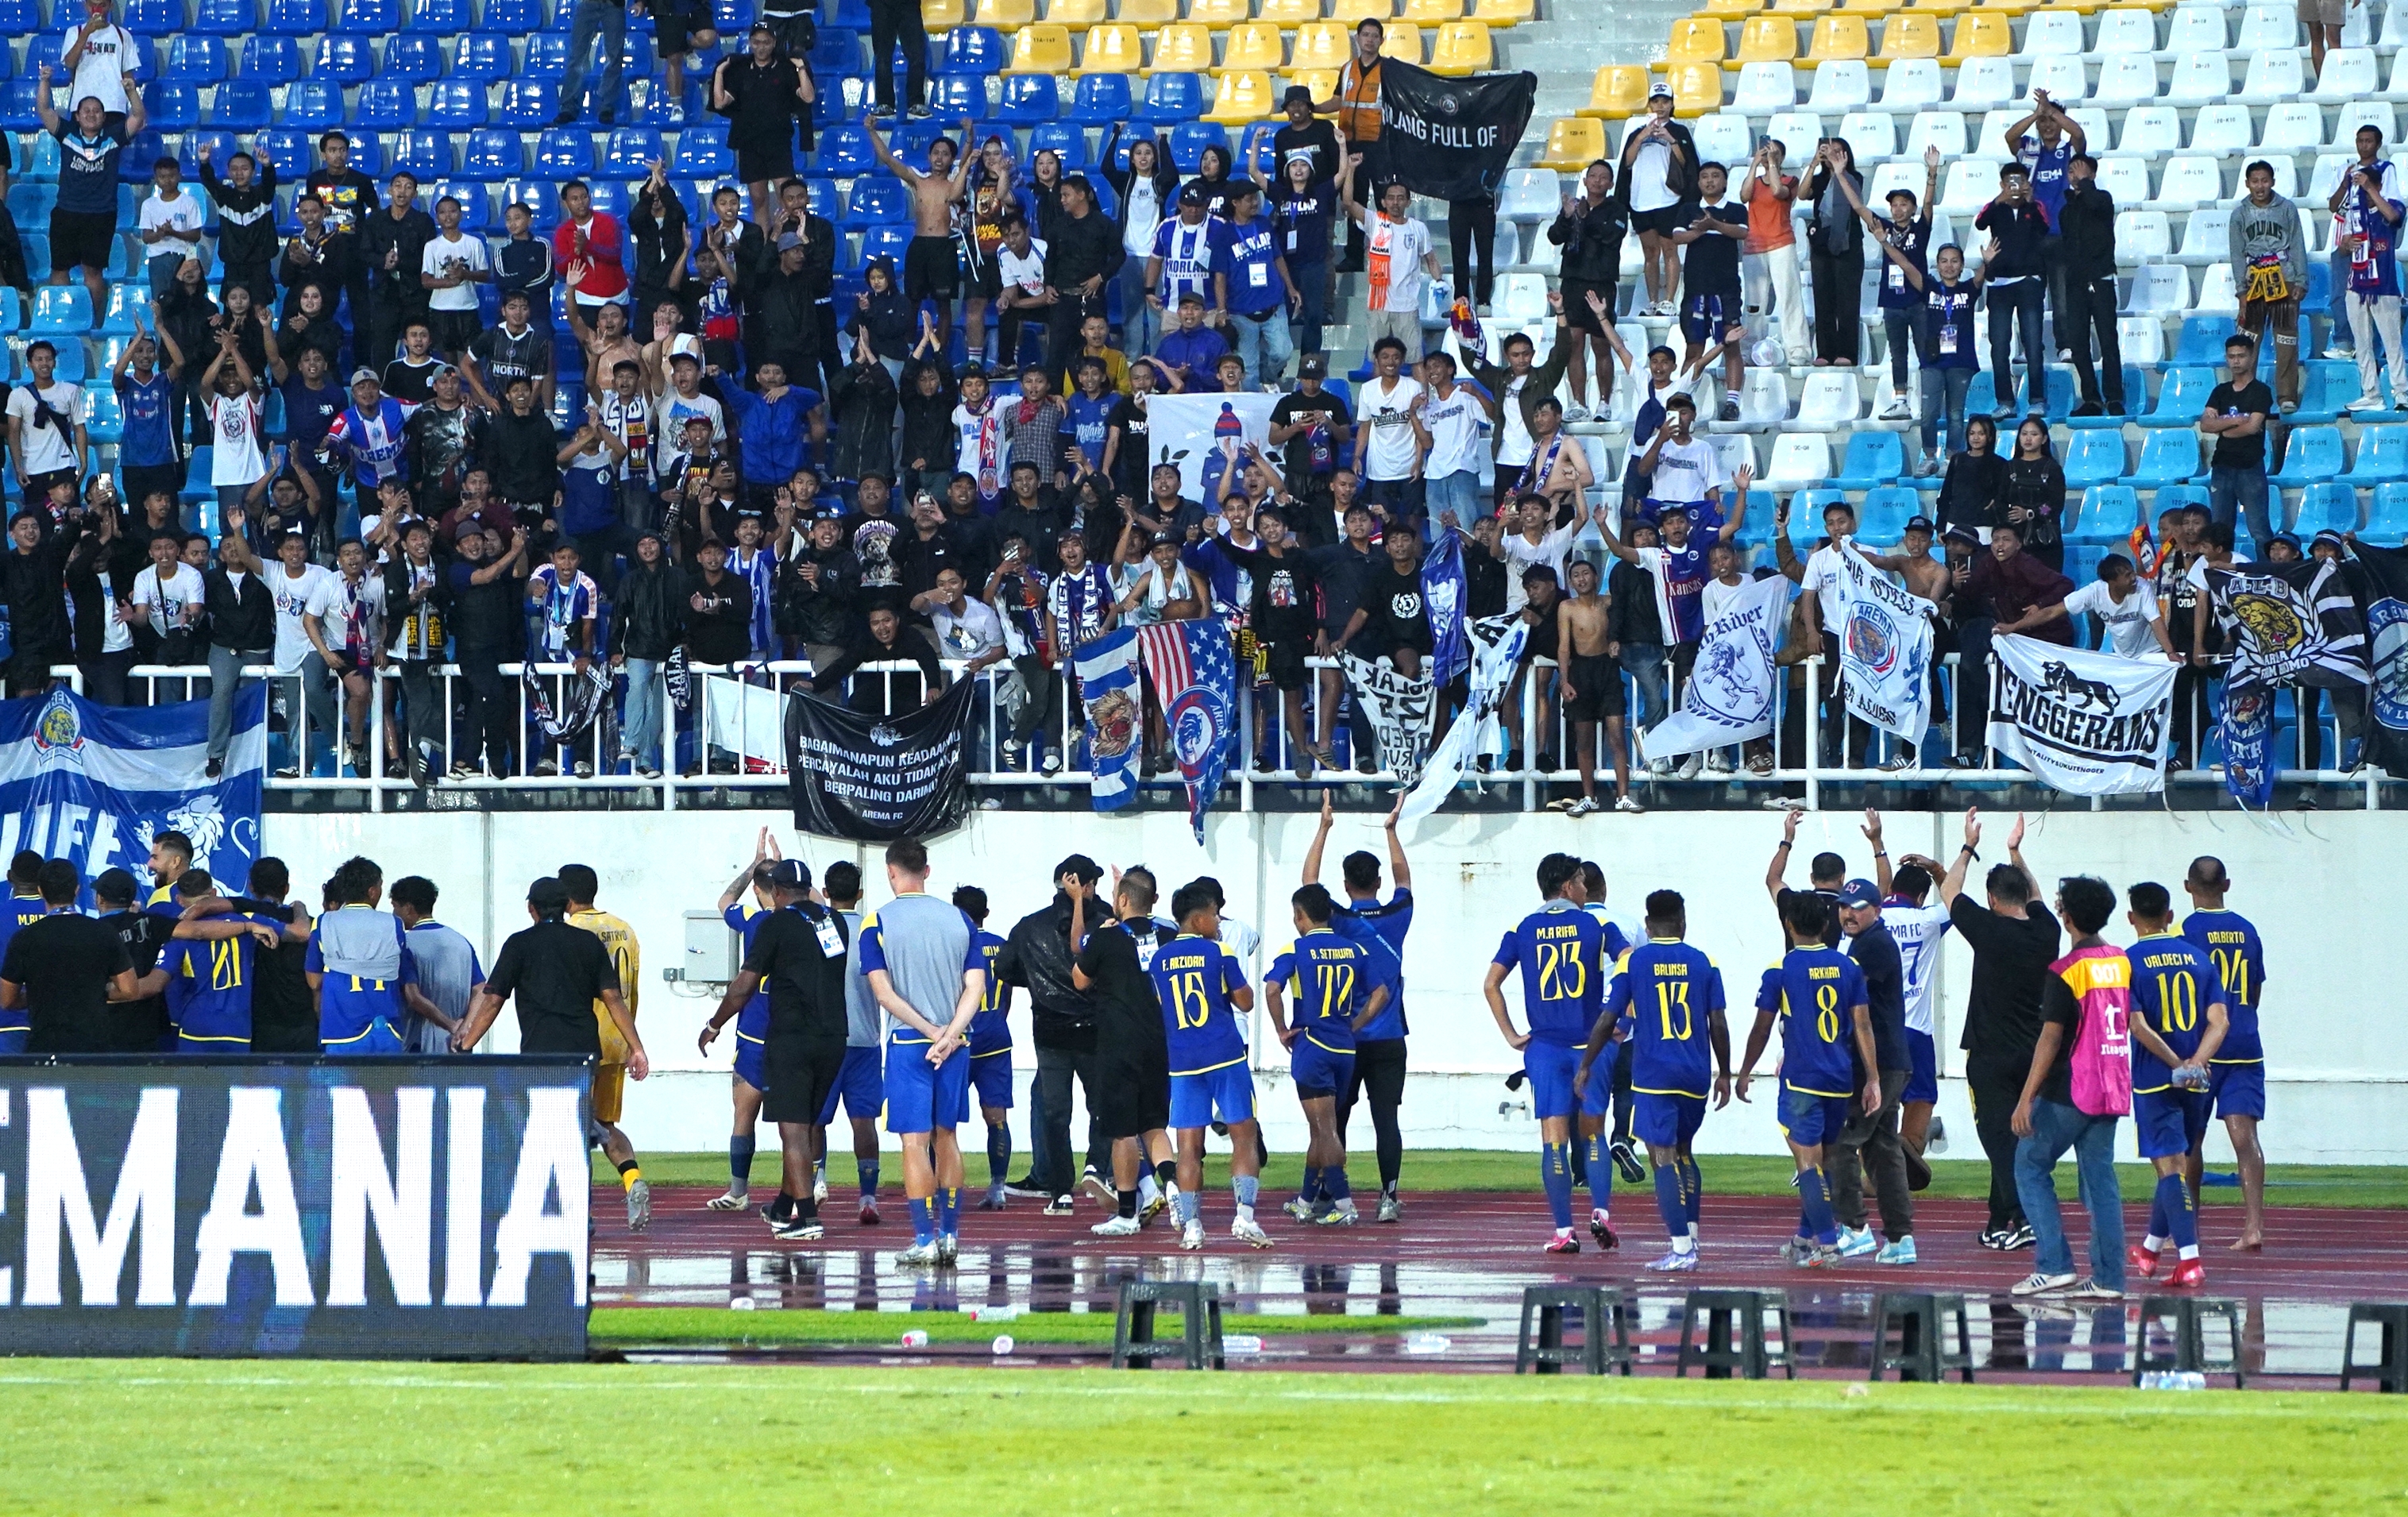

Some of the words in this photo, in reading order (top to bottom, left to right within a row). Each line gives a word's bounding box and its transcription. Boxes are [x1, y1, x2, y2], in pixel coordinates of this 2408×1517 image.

[1432, 123, 1473, 148] FULL
[1476, 125, 1498, 148] OF
[1669, 577, 1704, 597] Kansas
[1713, 604, 1765, 636] River
[1858, 604, 1893, 639] AREMA
[799, 735, 894, 767] BAGAIMANAPUN
[797, 755, 870, 782] PERCAYALAH
[873, 771, 901, 786] AKU
[824, 780, 891, 803] BERPALING
[862, 809, 890, 820] AREMA
[1910, 924, 1922, 937] FC
[2207, 931, 2245, 944] DALBERTO
[1162, 958, 1169, 972] F.
[1310, 948, 1320, 960] B.
[1320, 948, 1355, 960] SETIAWAN
[1901, 940, 1923, 986] 7
[2143, 953, 2182, 969] VALDECI
[2183, 953, 2198, 967] M.
[1536, 940, 1586, 1002] 23
[1653, 963, 1688, 976] BALINSA
[1808, 967, 1841, 980] ARKHAN
[2090, 963, 2121, 984] 001
[1169, 971, 1210, 1030] 15
[1317, 963, 1355, 1019] 72
[2155, 971, 2197, 1033] 10
[1655, 981, 1692, 1041] 13
[1816, 984, 1839, 1044] 8
